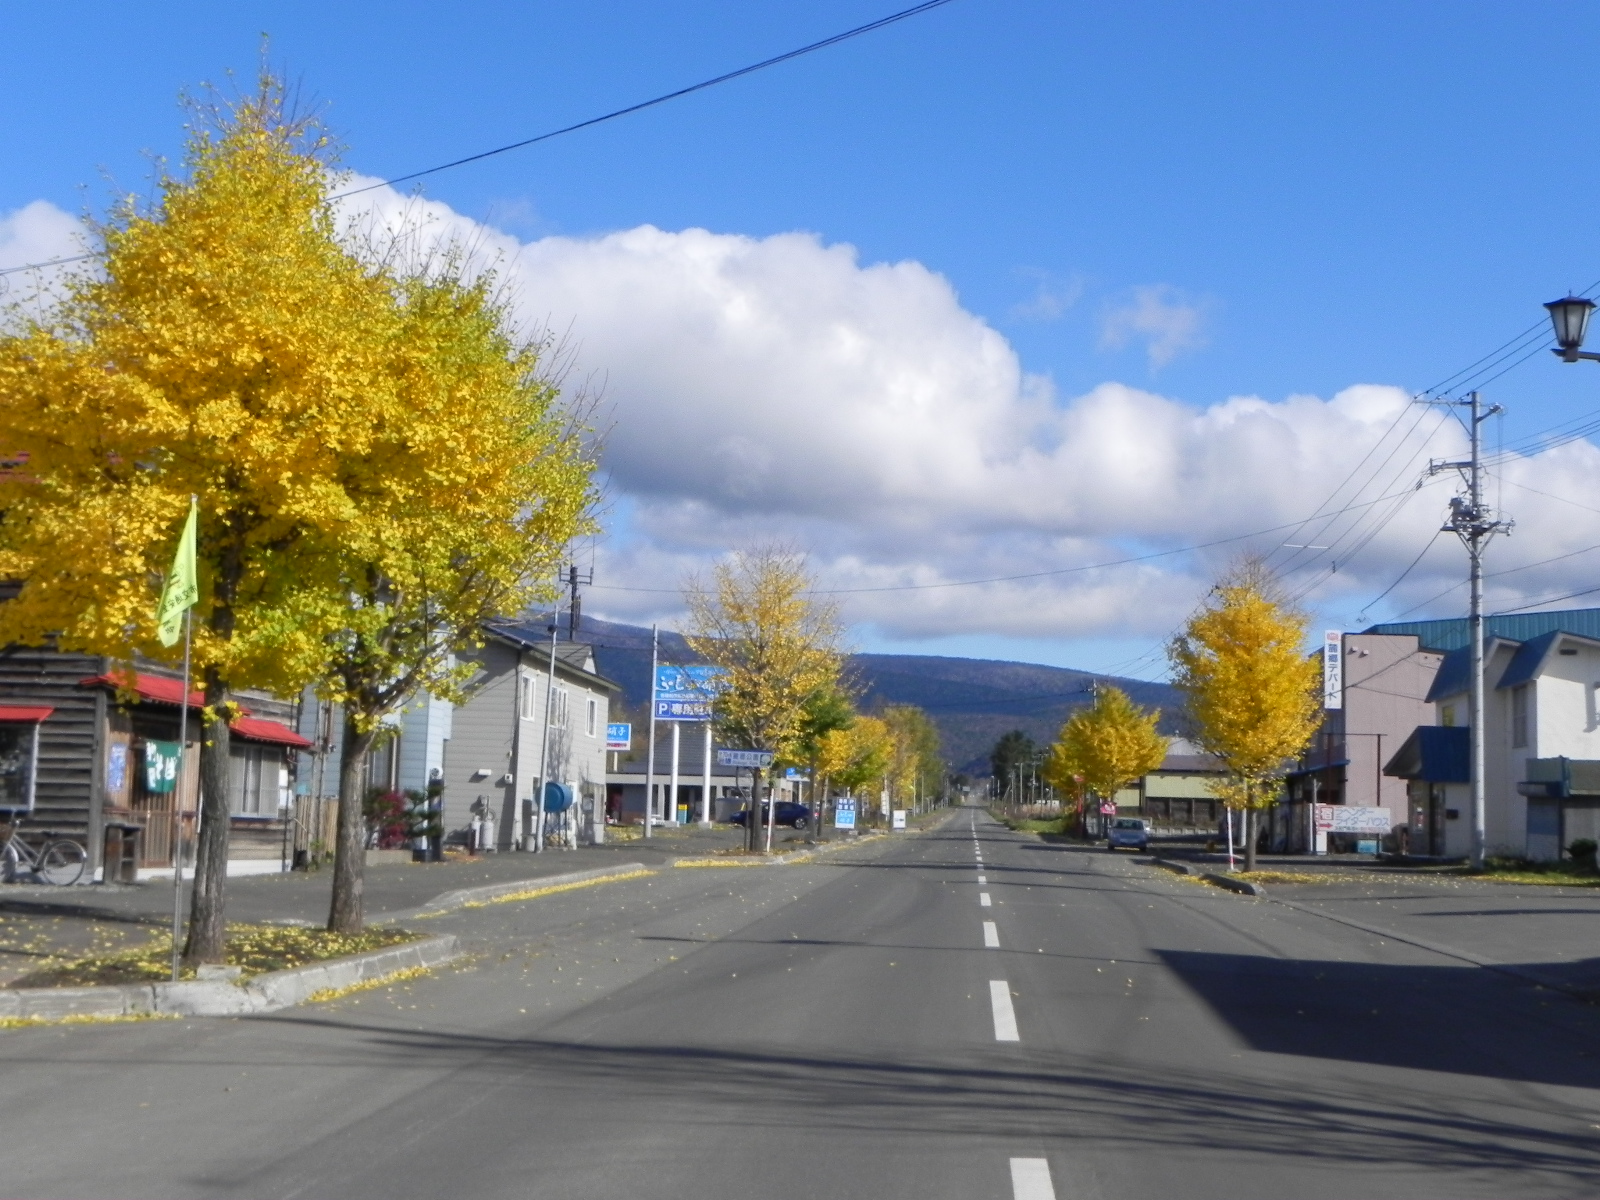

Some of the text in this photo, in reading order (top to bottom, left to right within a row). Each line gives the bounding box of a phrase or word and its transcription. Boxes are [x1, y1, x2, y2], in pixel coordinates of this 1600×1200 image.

[1327, 643, 1339, 702] 麓郷デパート
[658, 703, 668, 715] P
